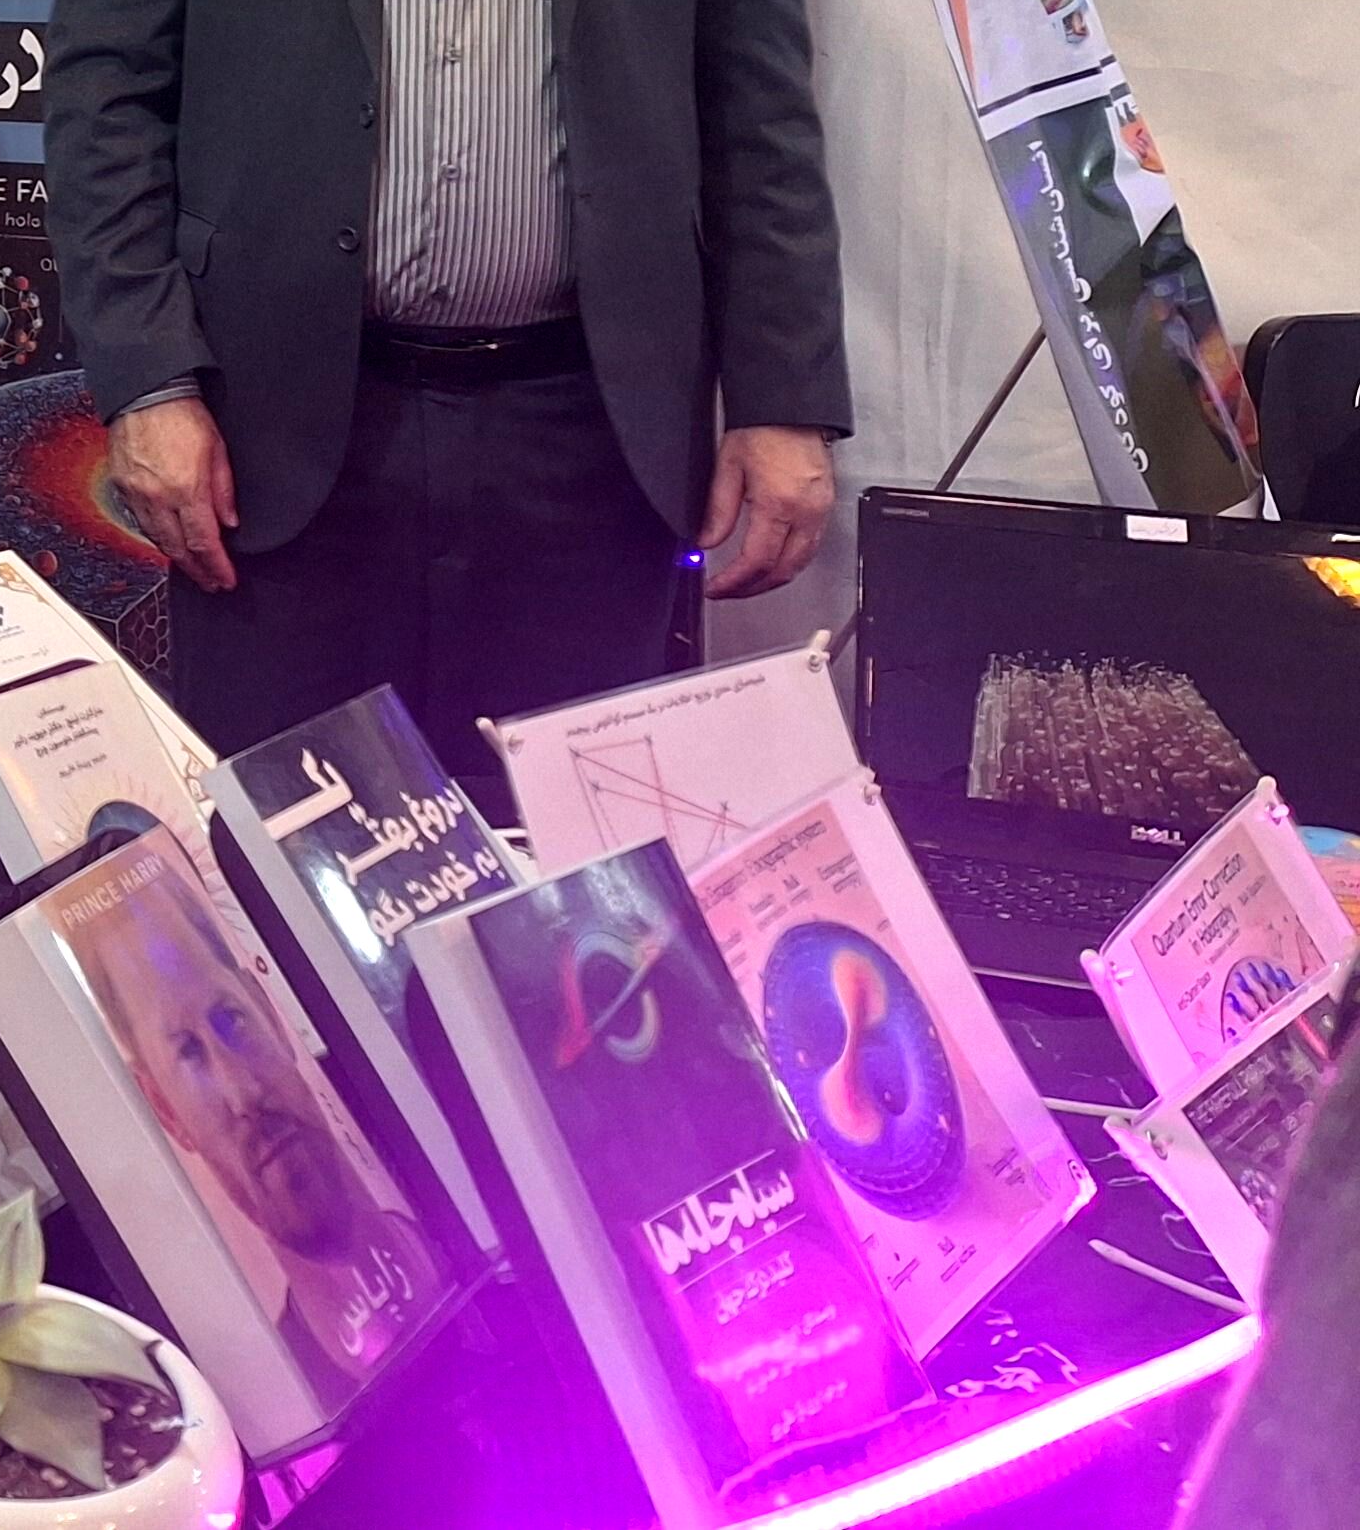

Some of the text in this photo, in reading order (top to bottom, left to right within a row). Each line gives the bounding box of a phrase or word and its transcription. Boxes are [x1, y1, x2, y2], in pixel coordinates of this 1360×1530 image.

[1026, 140, 1065, 212] انسان
[1080, 311, 1112, 370] برای
[62, 853, 164, 930] PRINCE HARRY
[405, 850, 479, 913] خودت
[473, 847, 506, 880] به
[1152, 853, 1243, 956] Quantum Error Correction
[1196, 904, 1238, 948] Holography
